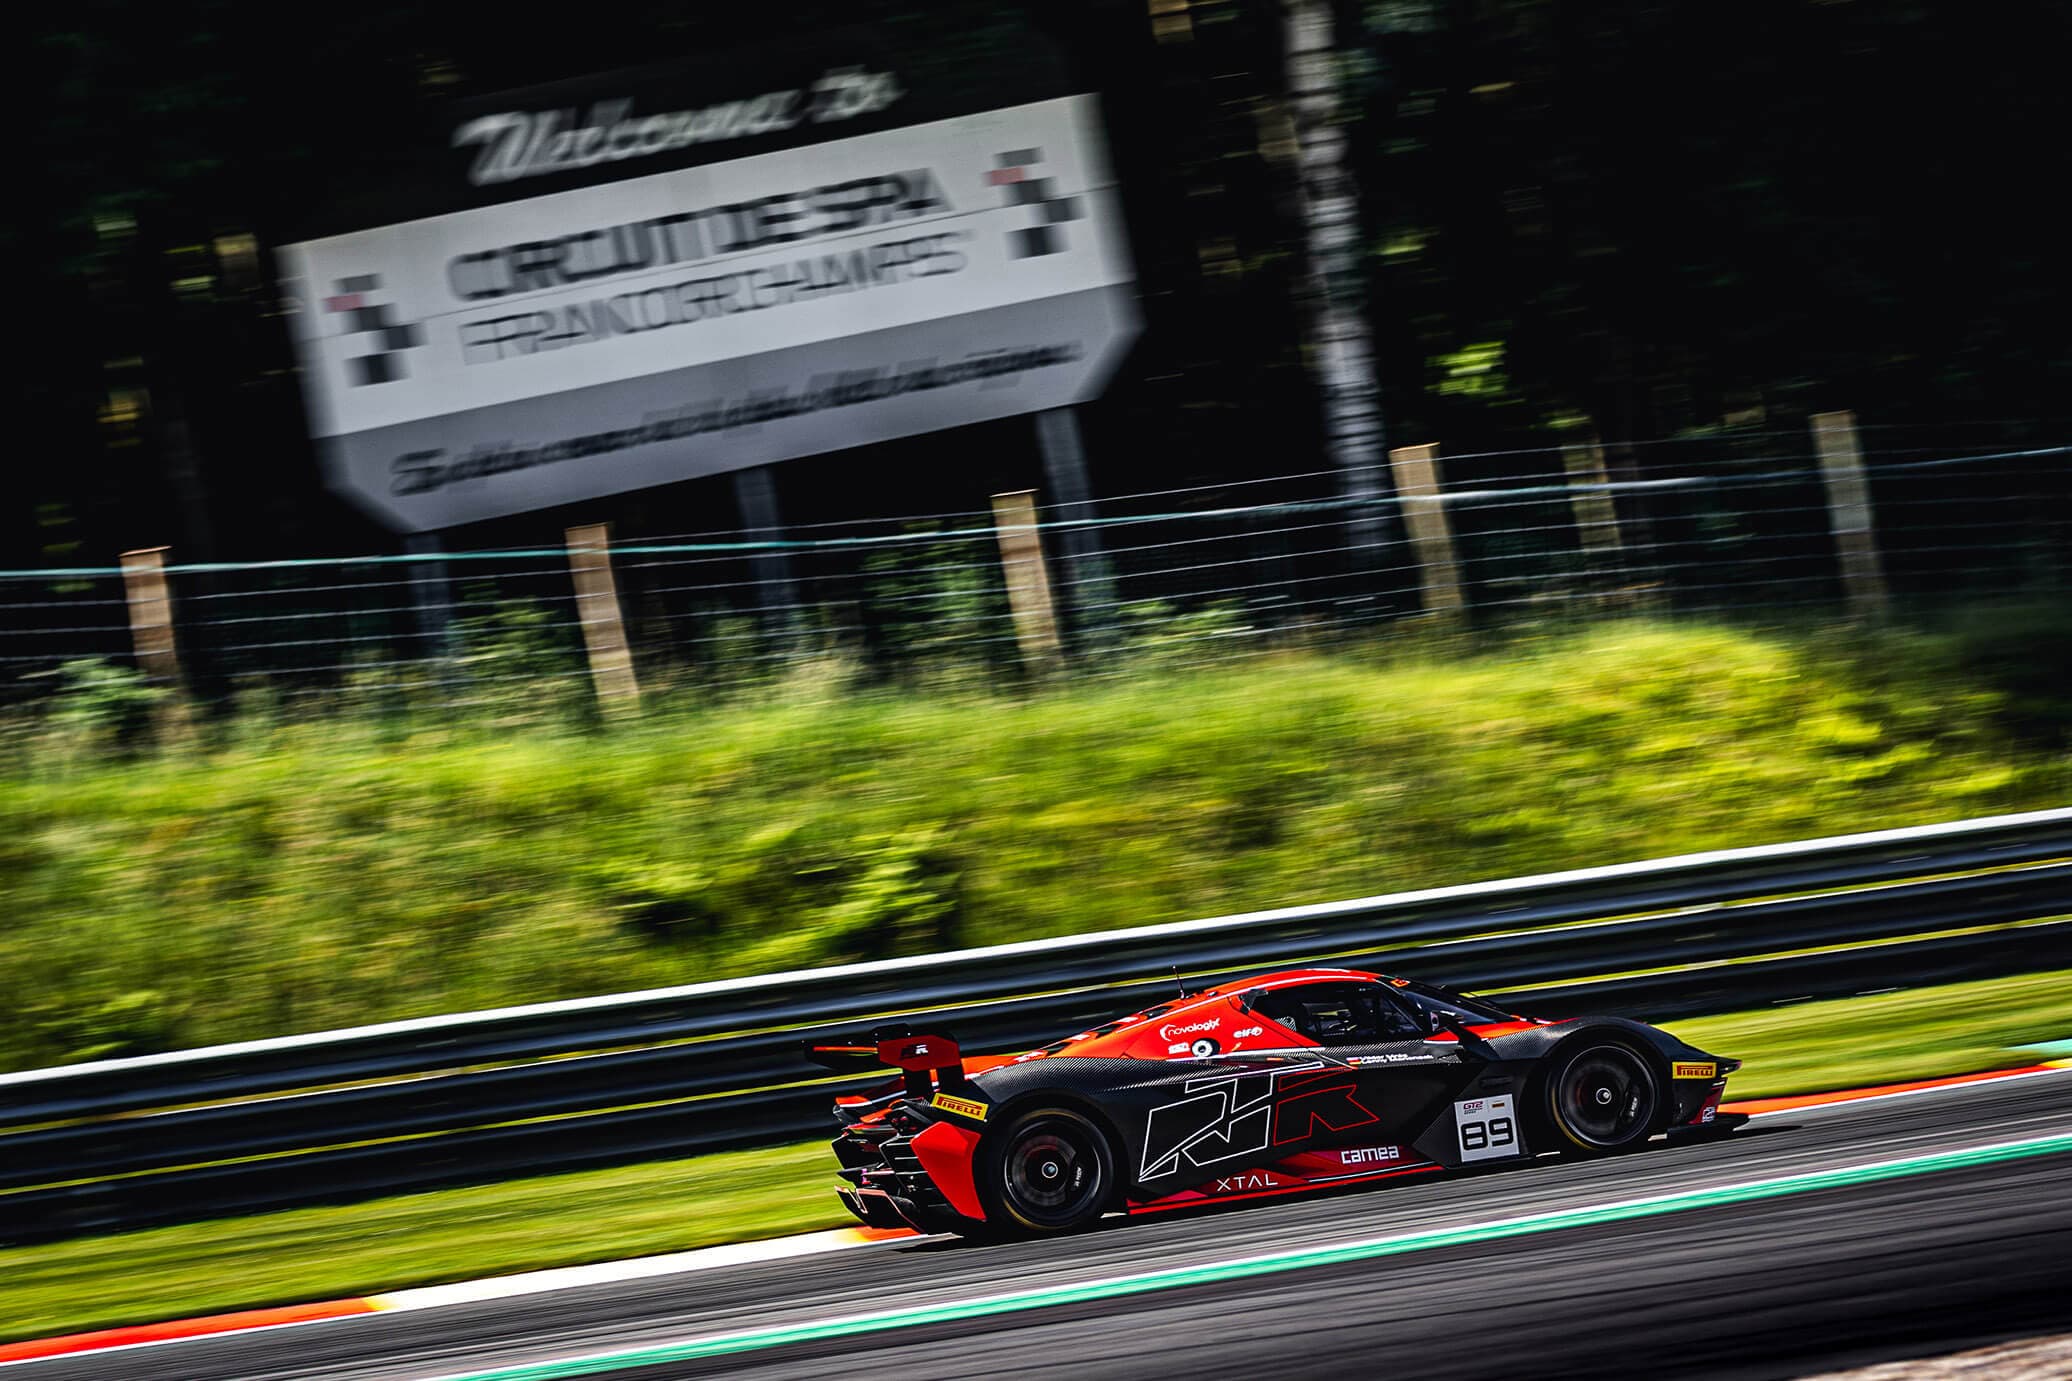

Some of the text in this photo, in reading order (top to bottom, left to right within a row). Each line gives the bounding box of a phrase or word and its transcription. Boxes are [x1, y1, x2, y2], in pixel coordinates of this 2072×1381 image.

[446, 209, 708, 302] CIRCUIT
[806, 167, 956, 236] SPA
[1676, 1065, 1713, 1076] PIRELLI
[936, 1096, 983, 1116] PIRELLI
[1461, 1117, 1514, 1150] 89
[1341, 1145, 1400, 1164] camea
[1217, 1173, 1278, 1192] XTAL
